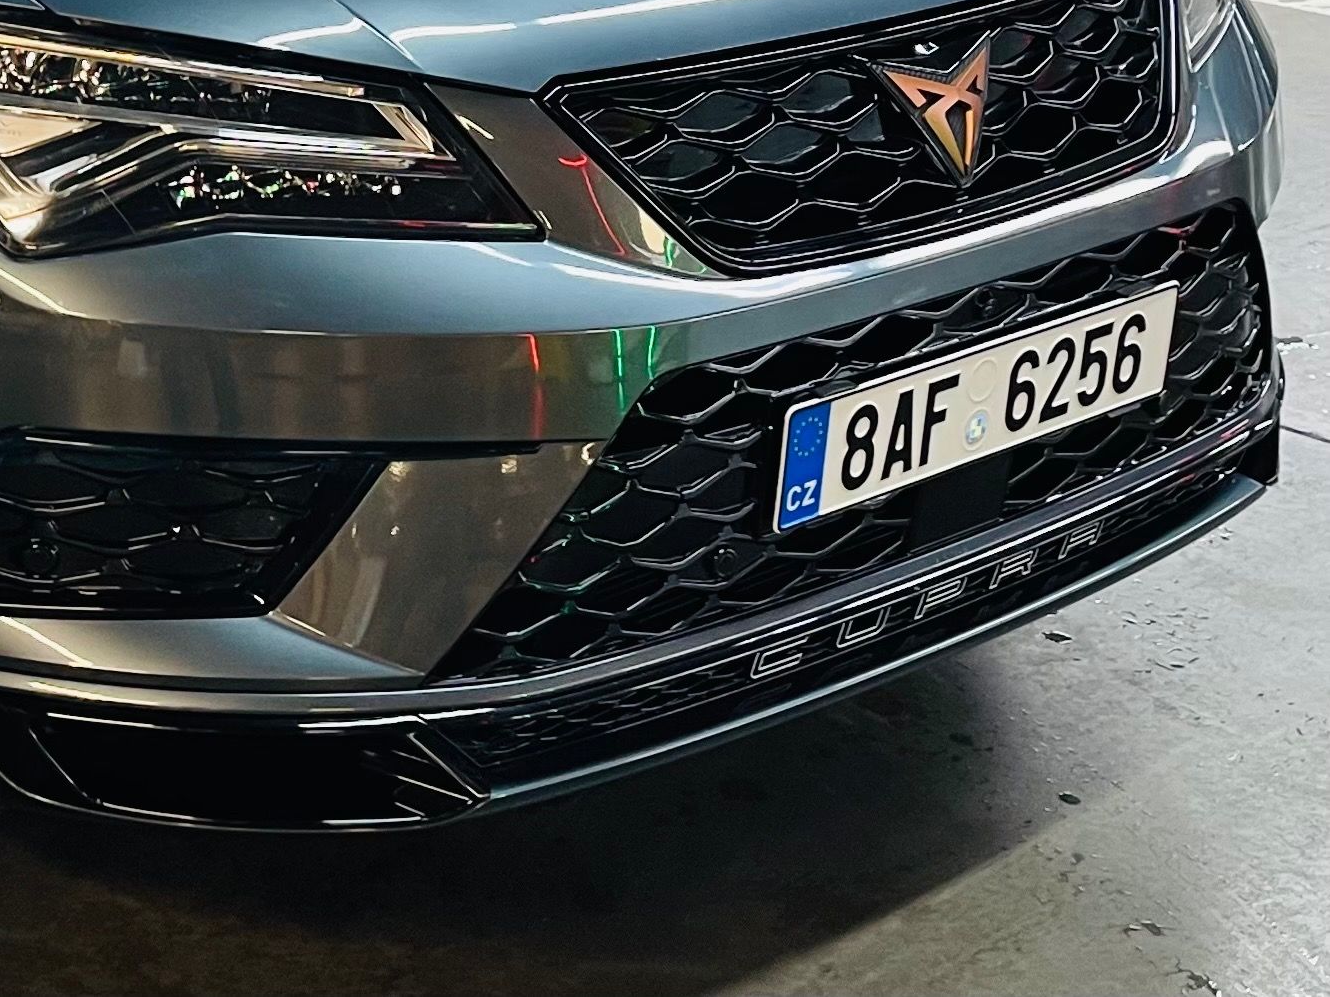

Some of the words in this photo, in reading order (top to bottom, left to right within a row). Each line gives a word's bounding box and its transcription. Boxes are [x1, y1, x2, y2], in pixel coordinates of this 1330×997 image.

[840, 373, 964, 491] 8AF
[1004, 313, 1147, 433] 6256
[785, 479, 818, 512] CZ
[750, 520, 1104, 680] CUPRA
